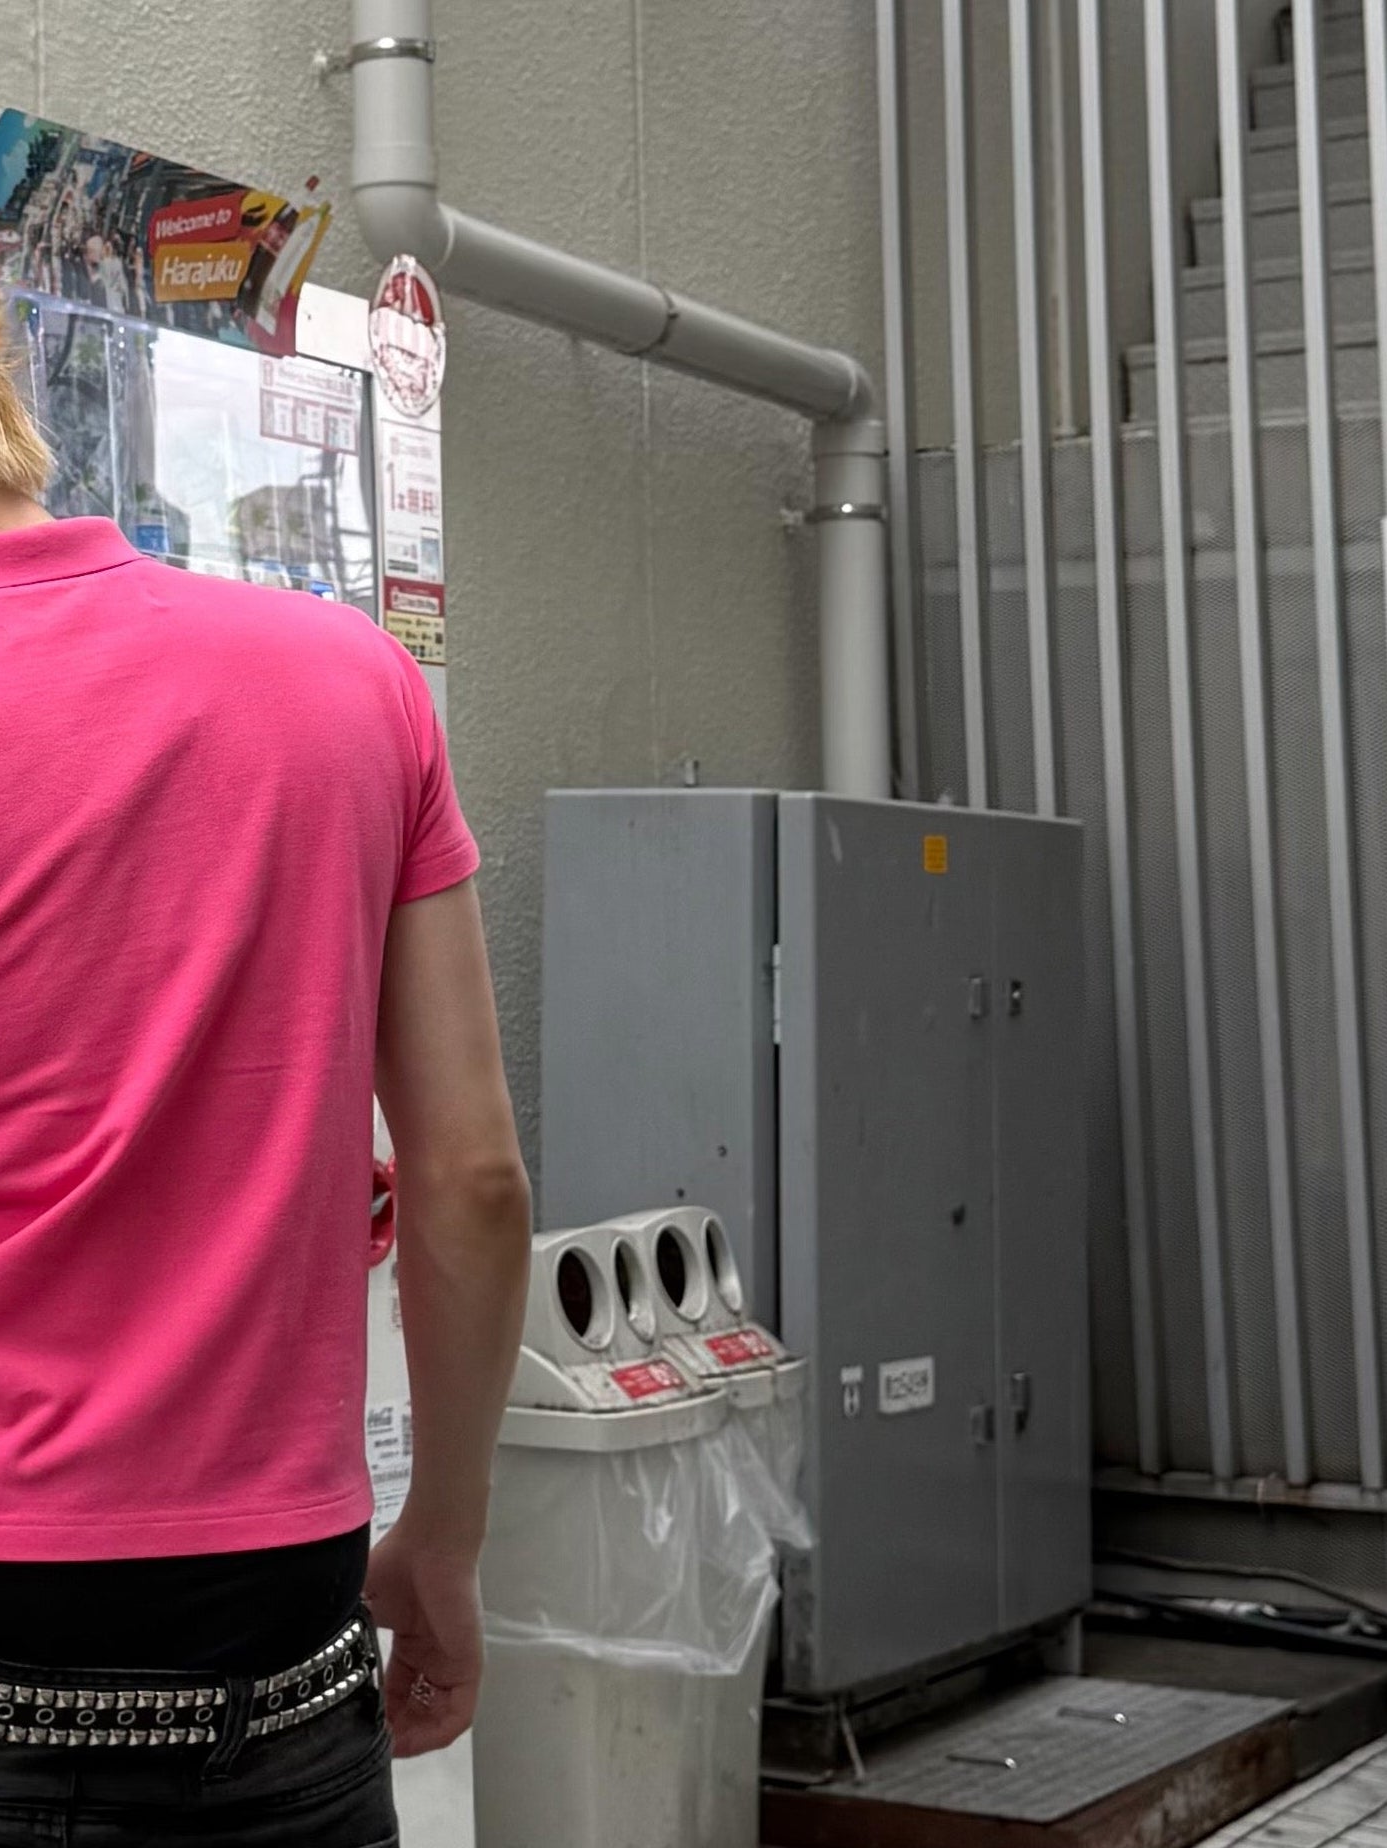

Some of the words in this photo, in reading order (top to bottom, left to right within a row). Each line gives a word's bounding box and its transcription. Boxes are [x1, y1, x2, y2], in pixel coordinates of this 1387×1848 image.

[154, 211, 216, 240] Welcome
[216, 206, 233, 226] to
[160, 253, 243, 291] Harajuku
